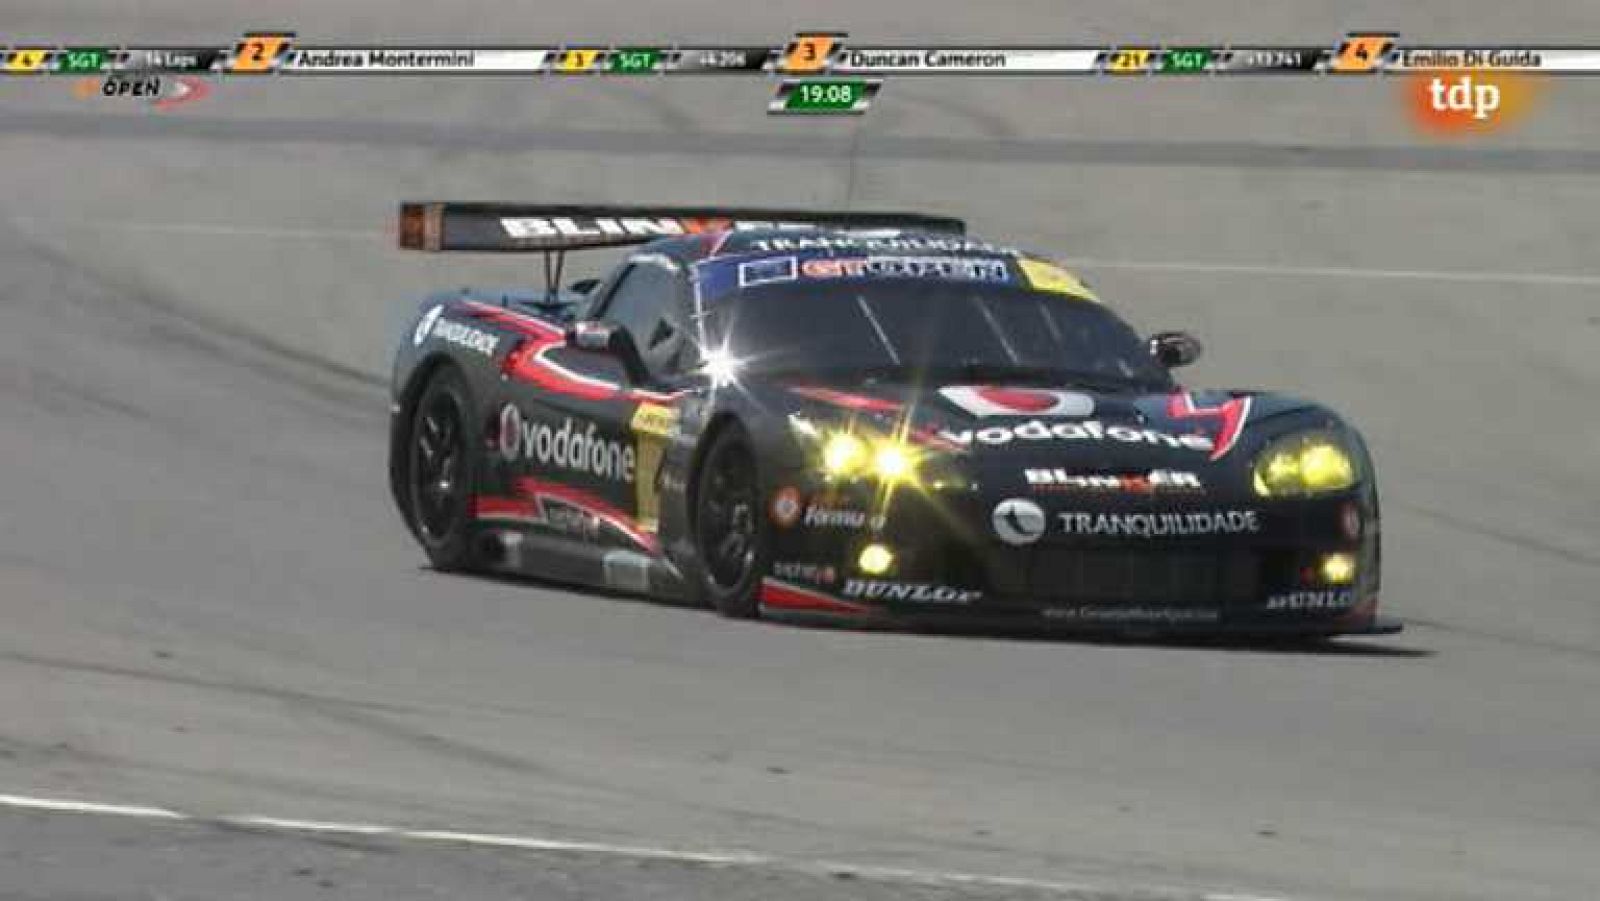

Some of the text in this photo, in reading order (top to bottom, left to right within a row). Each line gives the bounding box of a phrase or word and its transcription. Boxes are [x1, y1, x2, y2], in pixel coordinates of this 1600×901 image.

[521, 416, 636, 484] vodafone
[938, 420, 1214, 451] vodafone
[1057, 509, 1262, 536] TRANQUILIDADE
